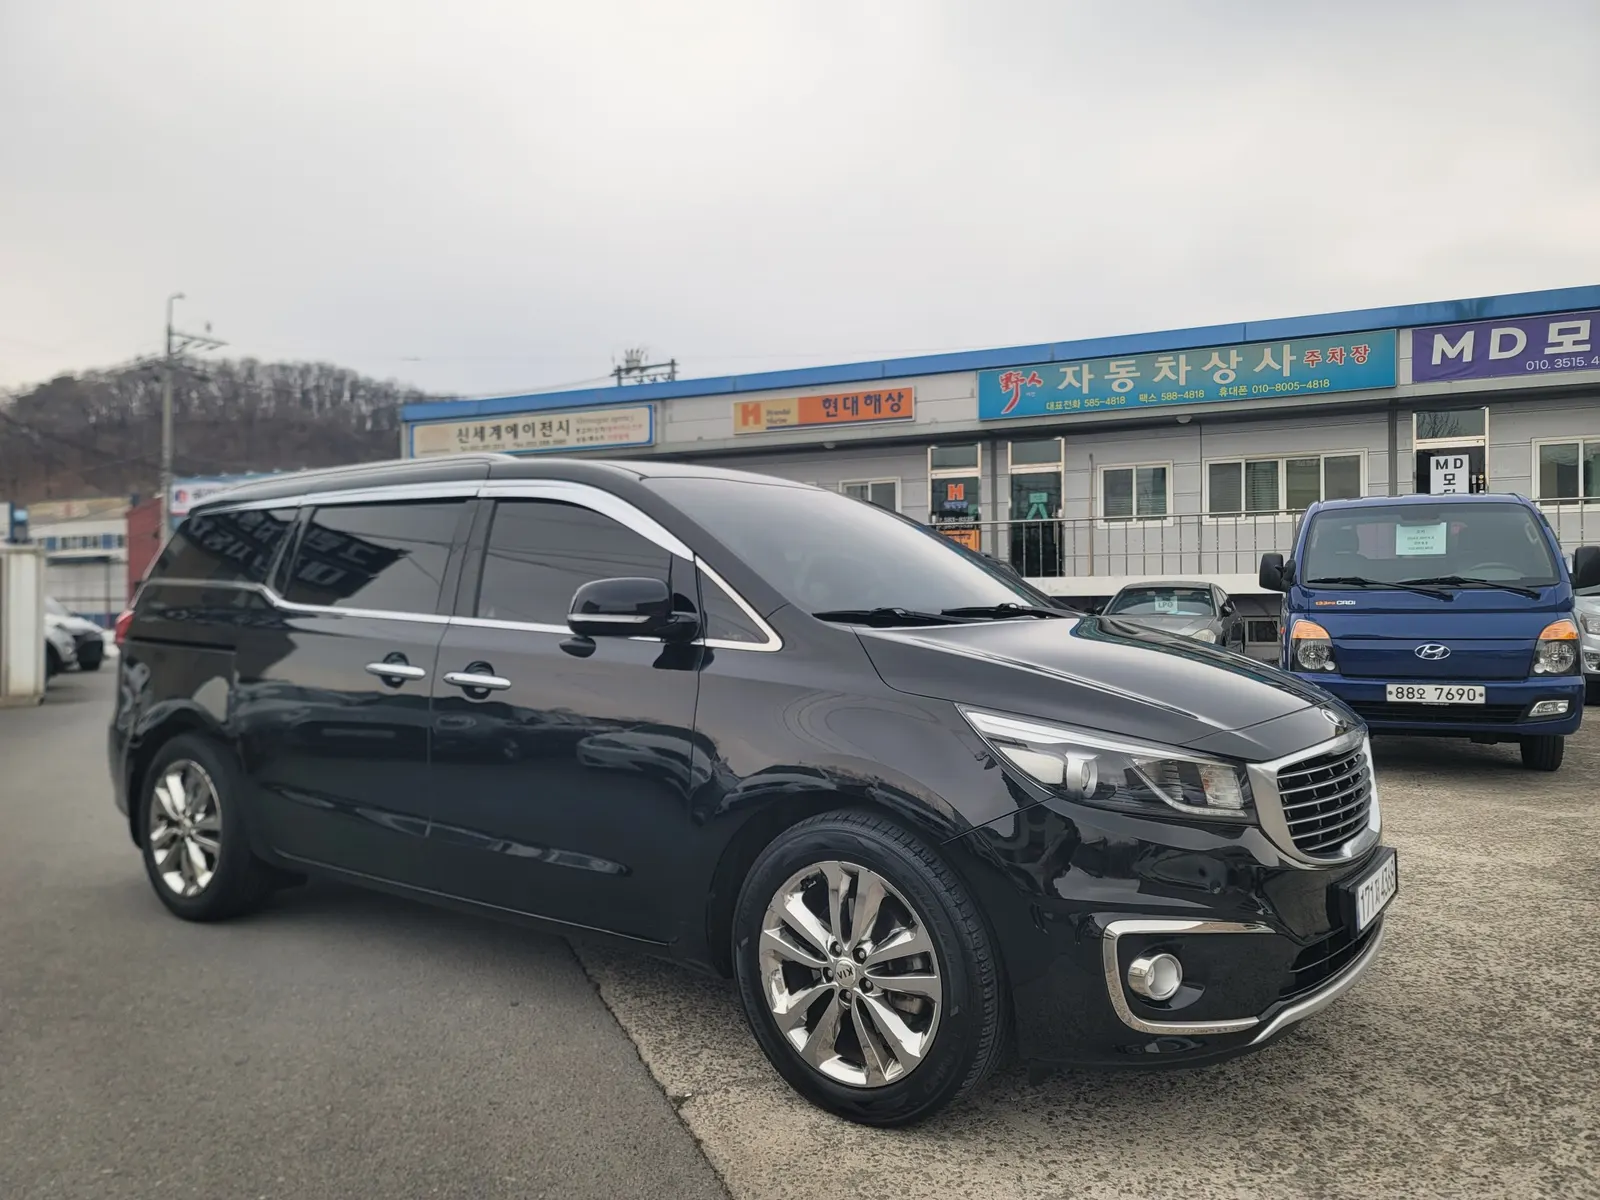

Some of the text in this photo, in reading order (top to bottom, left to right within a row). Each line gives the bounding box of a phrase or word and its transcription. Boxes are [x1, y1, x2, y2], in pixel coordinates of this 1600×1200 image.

[1057, 343, 1371, 394] 자동차상사 주차장
[822, 391, 904, 418] 현대해상
[1046, 399, 1081, 411] 대표전화
[1084, 396, 1126, 408] 585-4818
[1161, 389, 1205, 402] 588-4818
[1219, 385, 1248, 397] 휴대폰
[1252, 378, 1330, 394] 010-8005-4818
[456, 419, 571, 445] 신세계에이전시
[1395, 686, 1477, 702] 88오 7690
